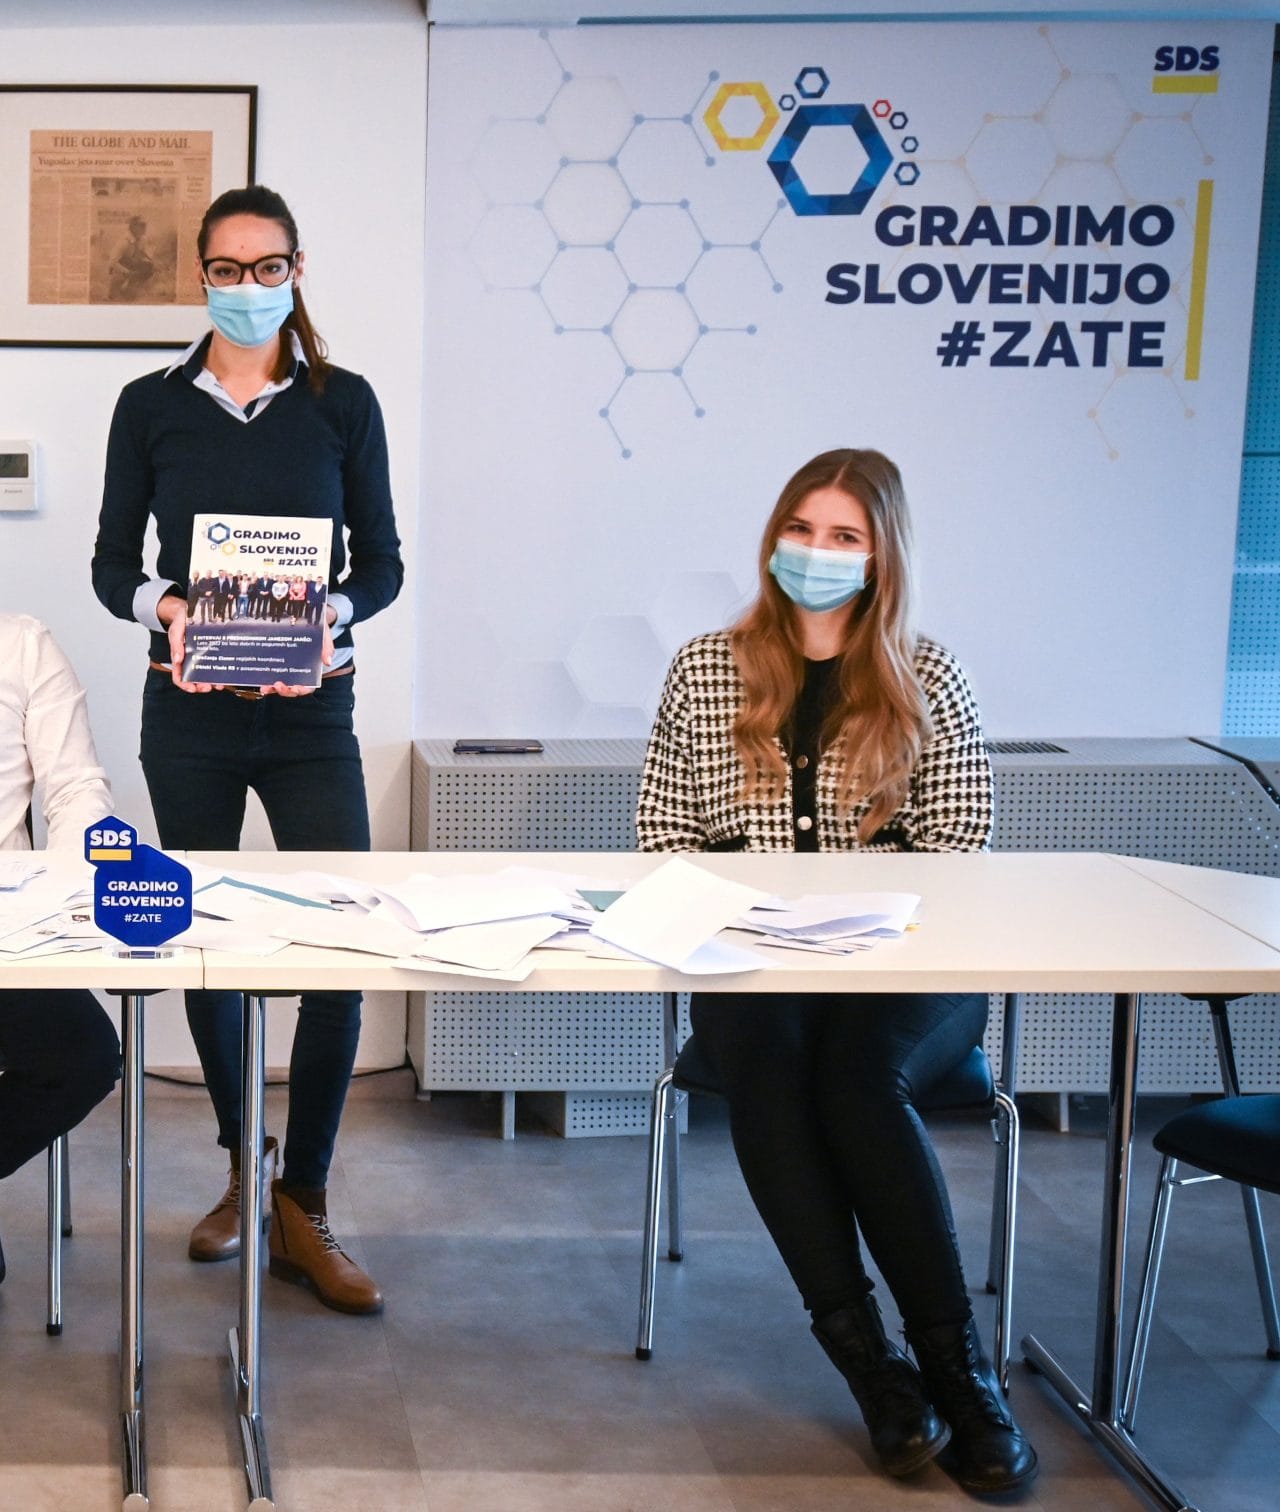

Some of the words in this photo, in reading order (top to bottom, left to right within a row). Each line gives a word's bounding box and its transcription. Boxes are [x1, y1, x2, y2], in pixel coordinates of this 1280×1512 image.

[1153, 46, 1220, 72] SDS
[52, 136, 78, 148] THE
[81, 136, 125, 148] GLOBE
[128, 137, 156, 148] AND
[159, 137, 191, 149] MAIL
[38, 156, 77, 167] Yugoslav
[137, 157, 174, 167] Slovenia
[874, 205, 1175, 247] GRADIMO
[825, 263, 1171, 305] SLOVENIJO
[936, 321, 1166, 367] #ZATE
[233, 530, 301, 540] GRADIMO
[239, 545, 318, 555] SLOVENIJO
[89, 829, 132, 846] SDS
[107, 881, 179, 892] GRADIMO
[101, 896, 185, 907] SLOVENIJO
[124, 913, 162, 923] #ZATE
